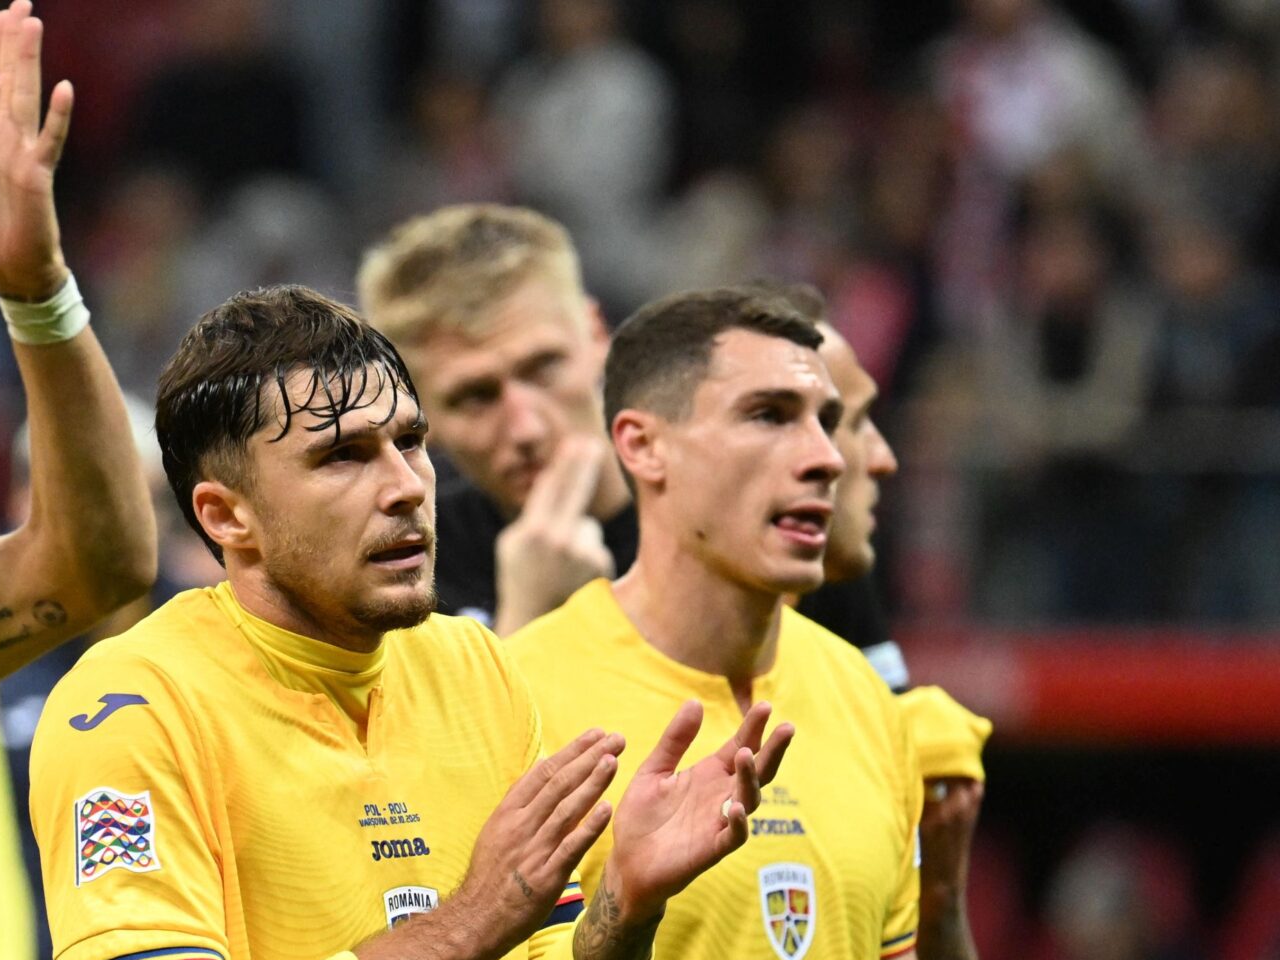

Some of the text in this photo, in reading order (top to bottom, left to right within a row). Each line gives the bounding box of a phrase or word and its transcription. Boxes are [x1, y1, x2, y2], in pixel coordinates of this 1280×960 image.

[364, 804, 382, 817] POL
[388, 802, 408, 815] ROU
[388, 888, 432, 912] ROMÂNIA
